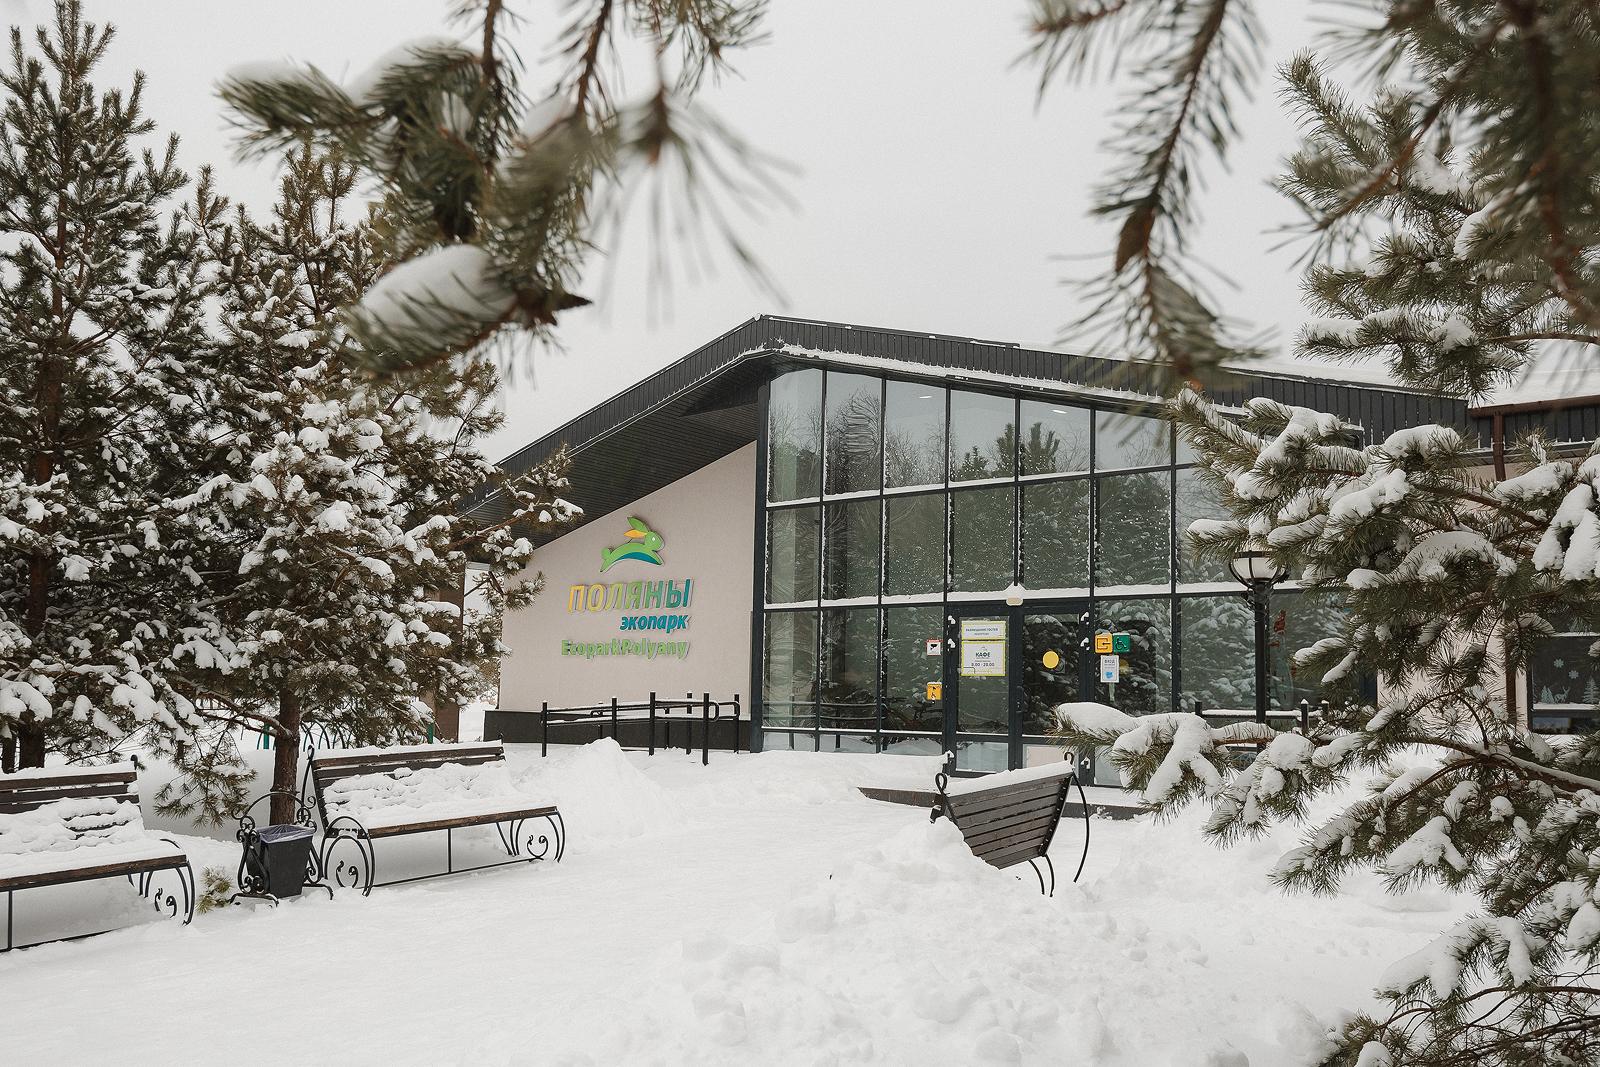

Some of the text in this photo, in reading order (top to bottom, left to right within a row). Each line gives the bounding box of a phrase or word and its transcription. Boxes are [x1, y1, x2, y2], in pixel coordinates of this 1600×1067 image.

[567, 578, 693, 614] ПОЛЯНЫ
[619, 614, 690, 634] экопарк
[561, 638, 691, 660] EcoparkPolyany
